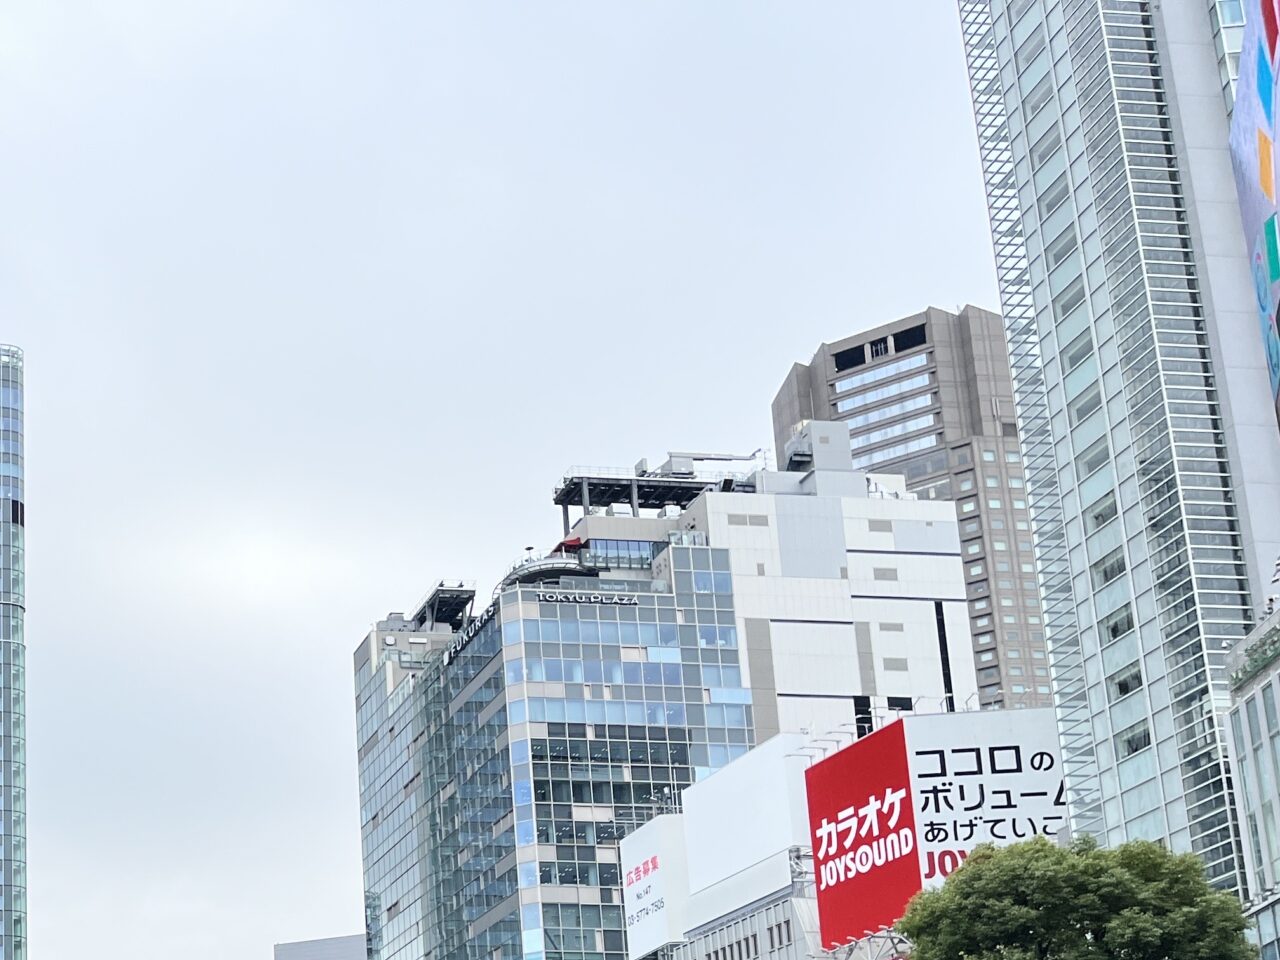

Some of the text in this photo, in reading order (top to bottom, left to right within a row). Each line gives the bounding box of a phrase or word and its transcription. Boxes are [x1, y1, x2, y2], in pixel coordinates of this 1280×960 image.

[537, 593, 640, 605] TOKYU PLAZA
[915, 745, 1055, 778] ココロの
[816, 787, 907, 860] カラオケ
[820, 827, 914, 891] JOYSOUND
